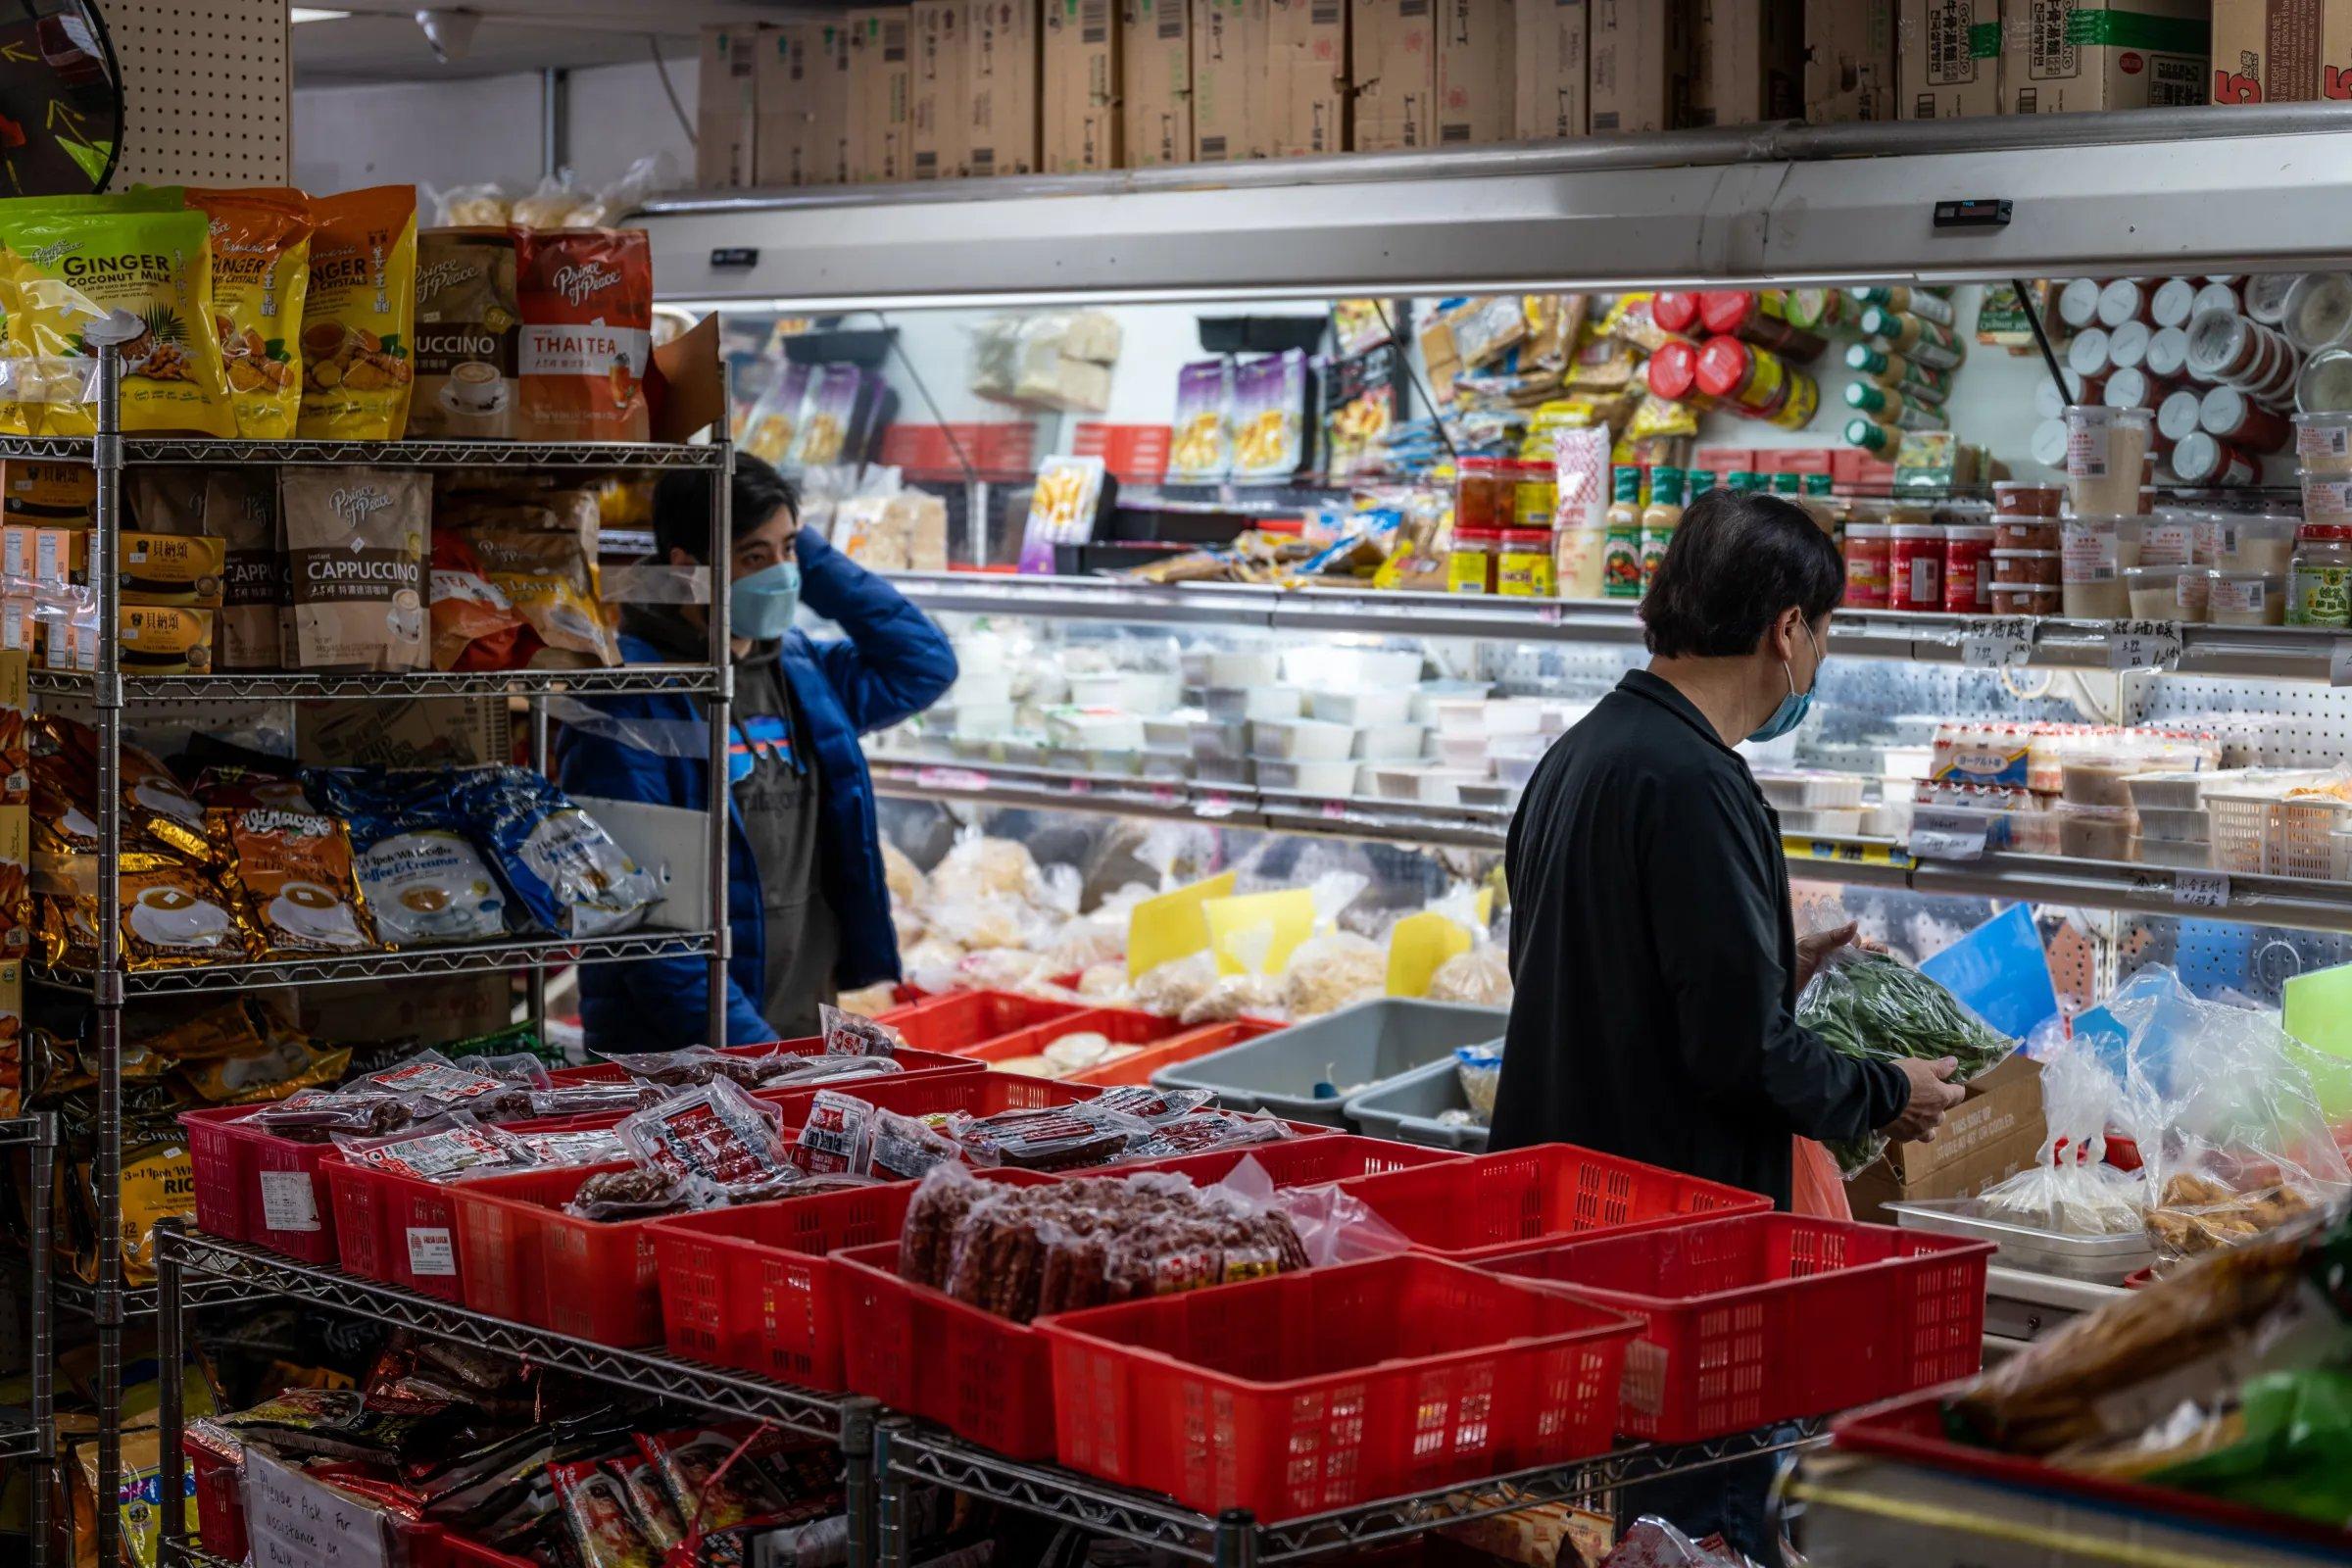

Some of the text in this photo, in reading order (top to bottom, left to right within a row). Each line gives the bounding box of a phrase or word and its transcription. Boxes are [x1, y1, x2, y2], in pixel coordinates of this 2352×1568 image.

[2215, 70, 2262, 104] 5
[63, 255, 170, 275] GINGER
[310, 258, 366, 284] NGER
[66, 270, 171, 288] COCONUT MILK
[553, 261, 605, 295] Prince
[580, 271, 620, 300] Peace
[416, 335, 495, 355] UCCINO
[534, 337, 615, 355] THAI TEA
[329, 485, 375, 517] Prince
[360, 493, 393, 520] Peace
[307, 562, 418, 581] CAPPUCCINO
[165, 1179, 194, 1194] RIC
[260, 1470, 292, 1508] Please
[302, 1495, 323, 1522] Ask
[270, 1543, 292, 1567] Bulk
[327, 1543, 339, 1558] on
